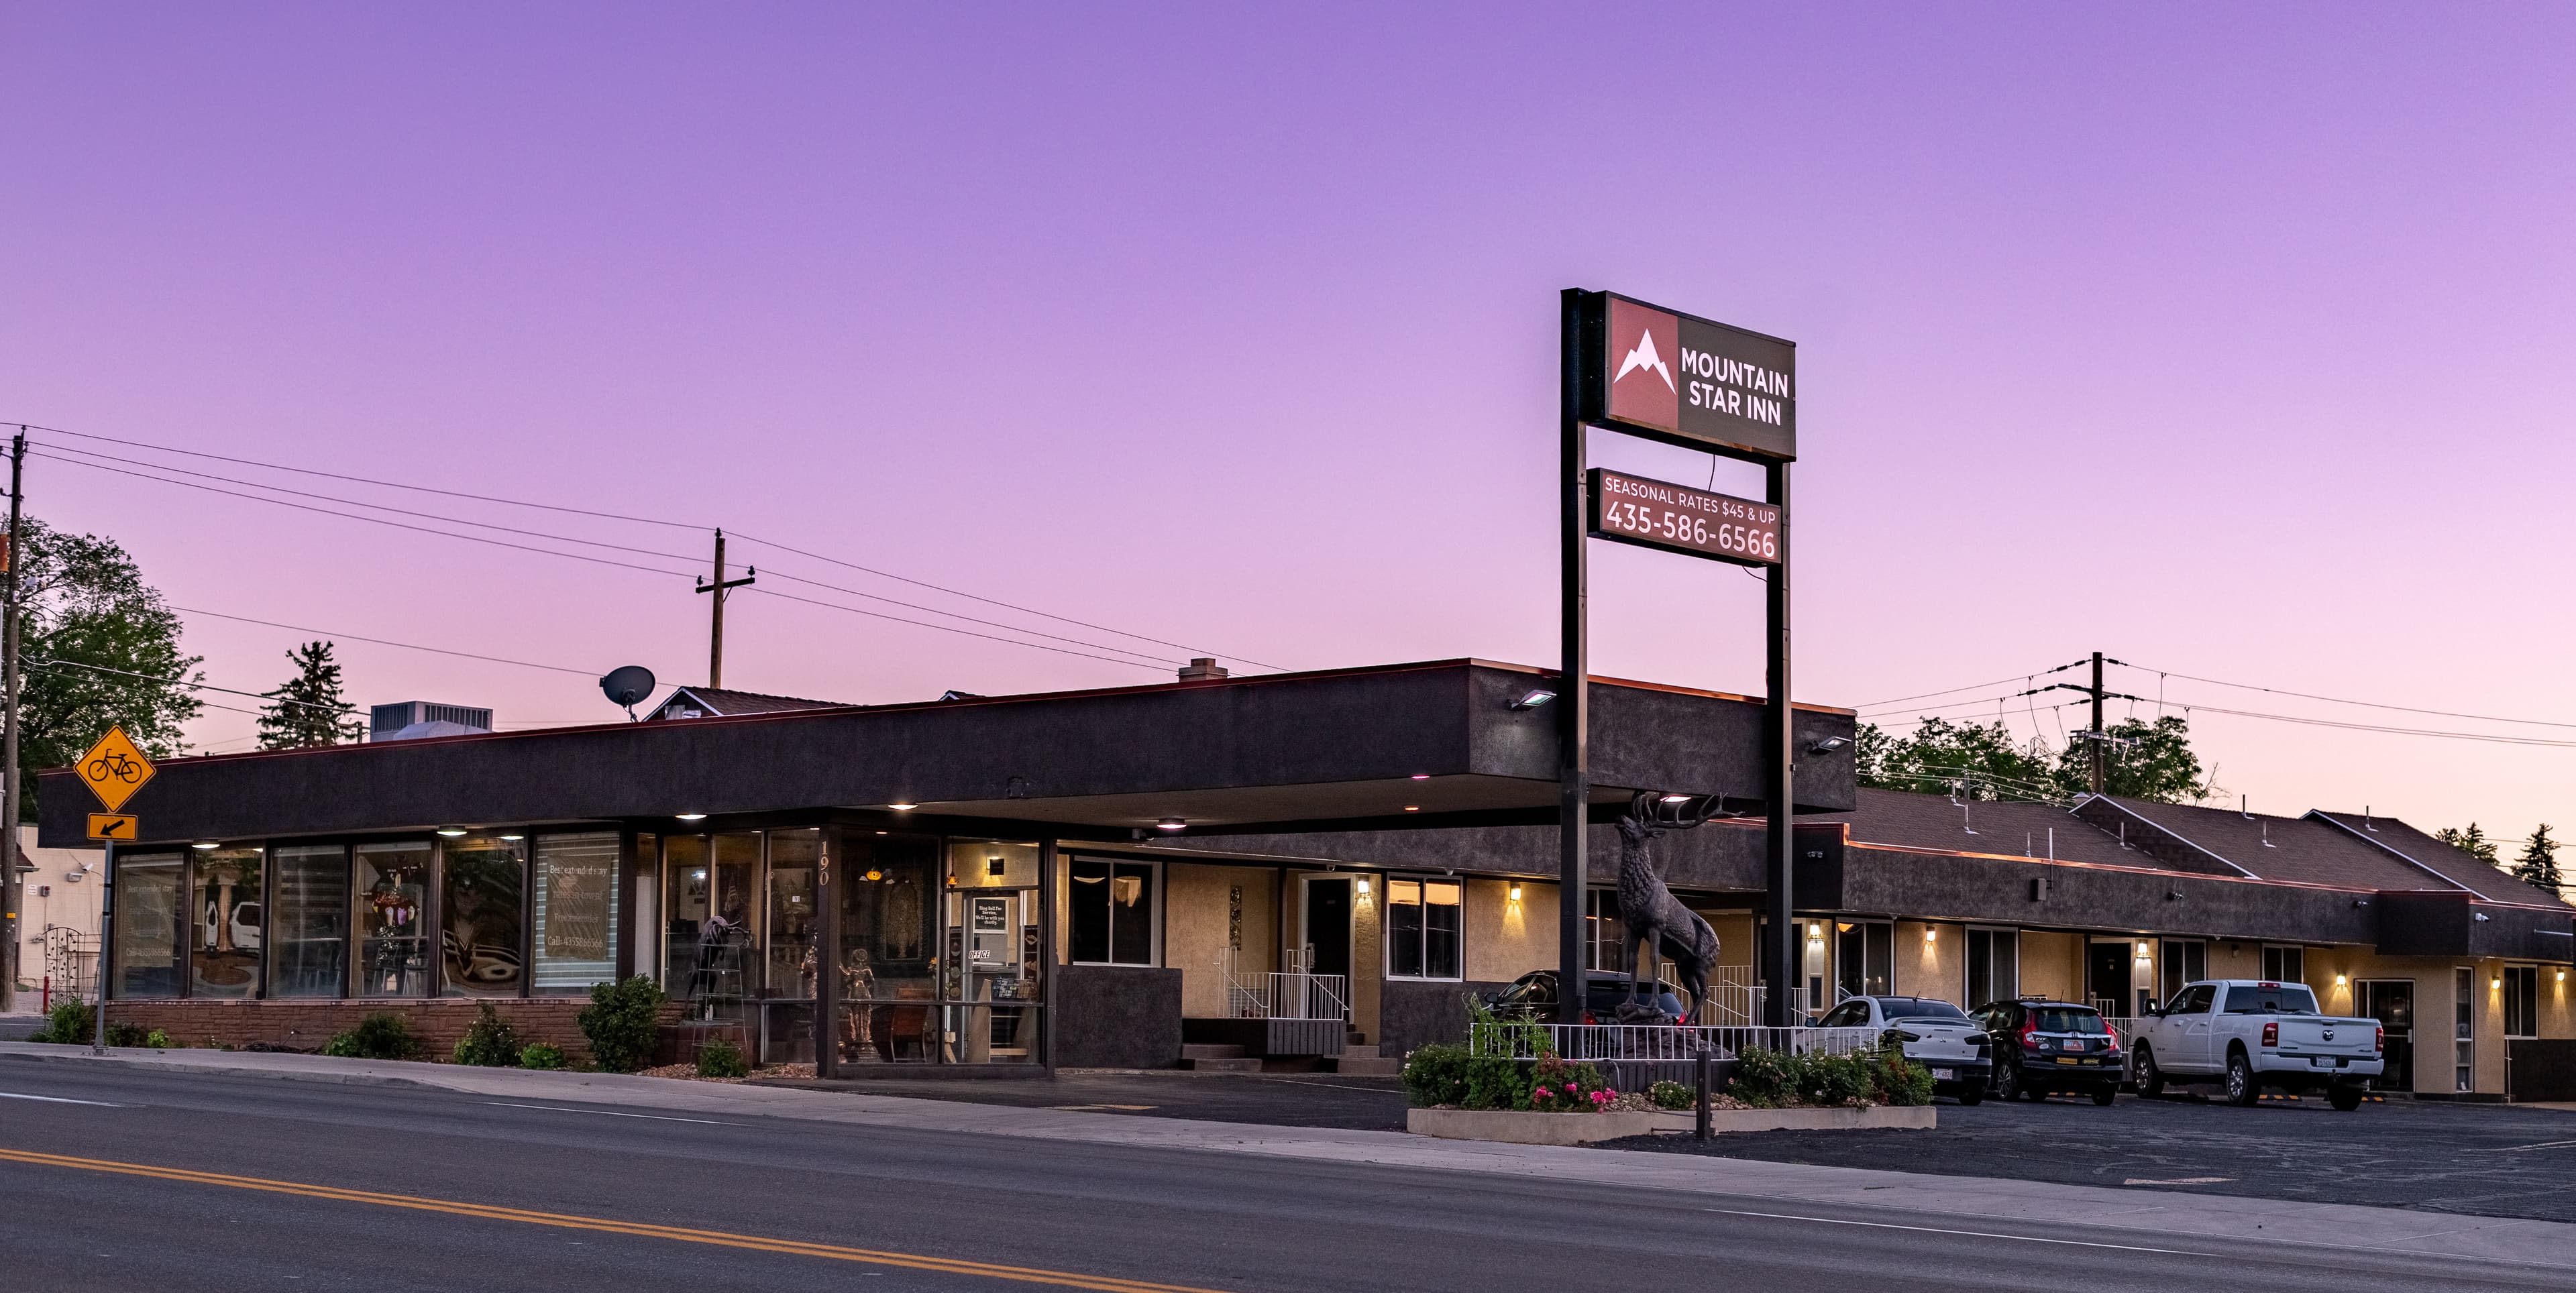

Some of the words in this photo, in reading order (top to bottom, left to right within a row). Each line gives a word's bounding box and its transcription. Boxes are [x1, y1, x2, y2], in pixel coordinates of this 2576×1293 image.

[1681, 347, 1788, 398] MOUNTAIN
[1689, 380, 1741, 416] STAR
[1747, 394, 1781, 426] INN
[1605, 477, 1674, 505] SEASONAL
[1678, 492, 1718, 513] RATES
[1722, 500, 1744, 519] $45
[1748, 506, 1755, 520] &
[1760, 509, 1776, 525] UP
[1607, 501, 1775, 557] 435-586-6566
[819, 841, 829, 885] 190
[969, 950, 990, 958] OFFICE
